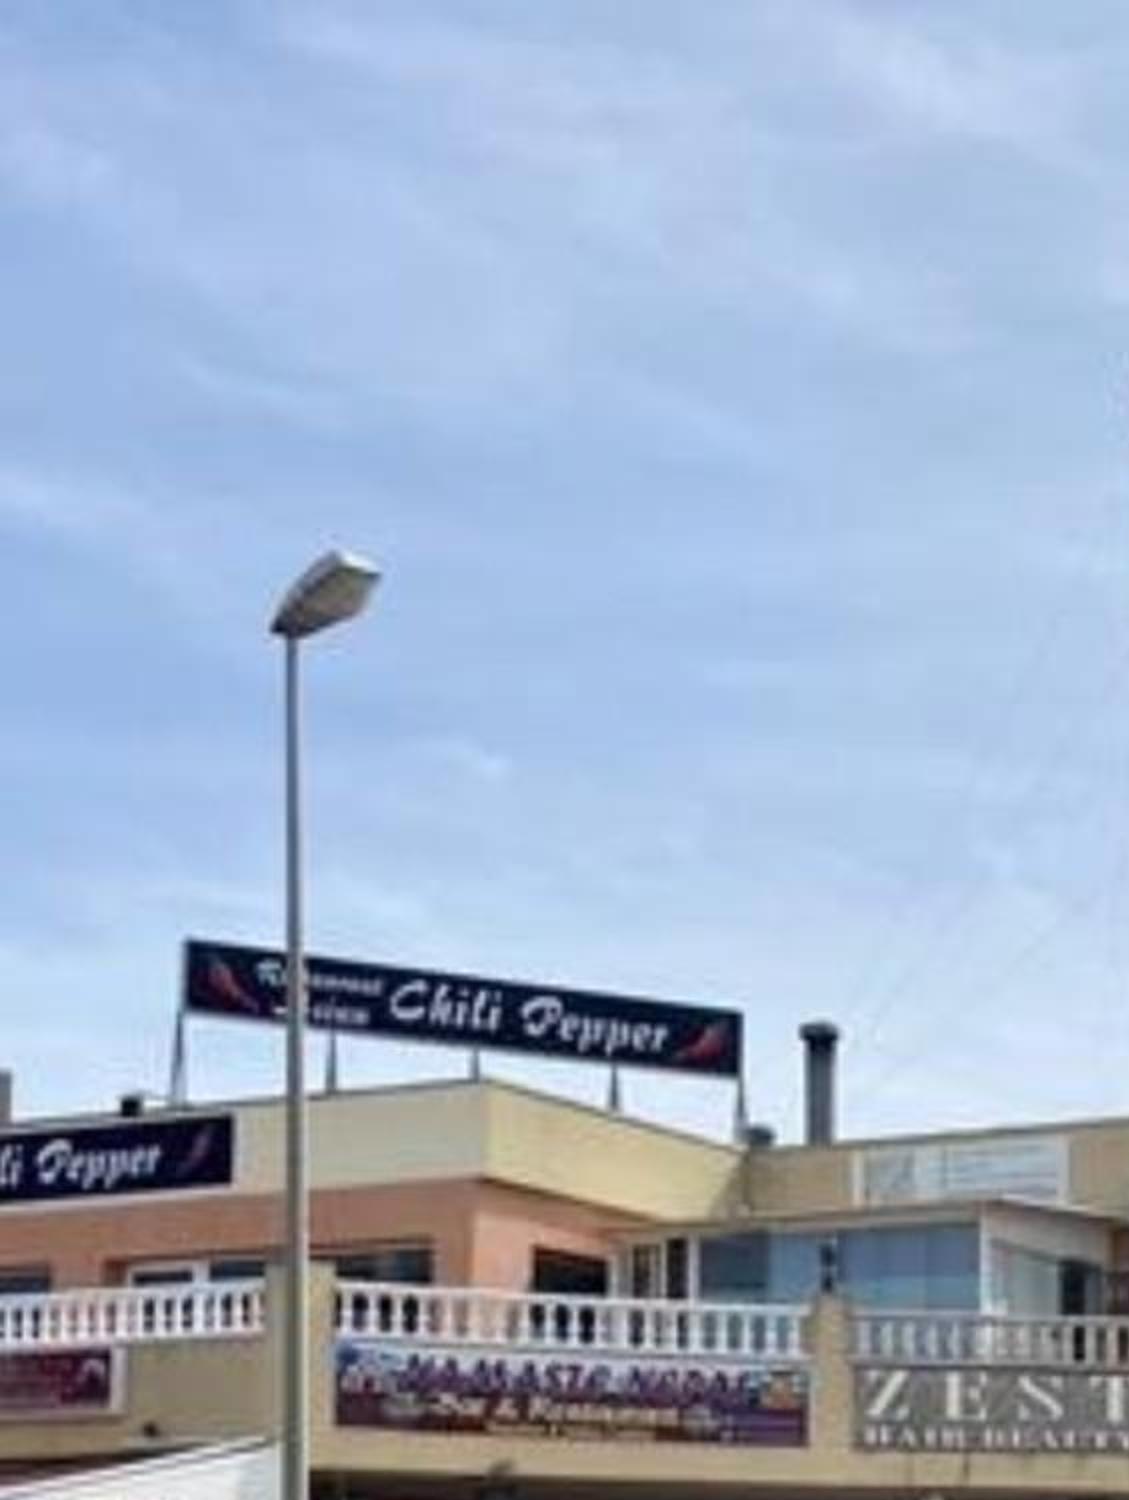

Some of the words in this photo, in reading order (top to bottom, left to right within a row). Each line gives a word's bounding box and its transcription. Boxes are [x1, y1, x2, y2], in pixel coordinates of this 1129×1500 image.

[389, 979, 501, 1033] Chili
[521, 995, 669, 1055] Pepper
[37, 1137, 161, 1190] Pepper
